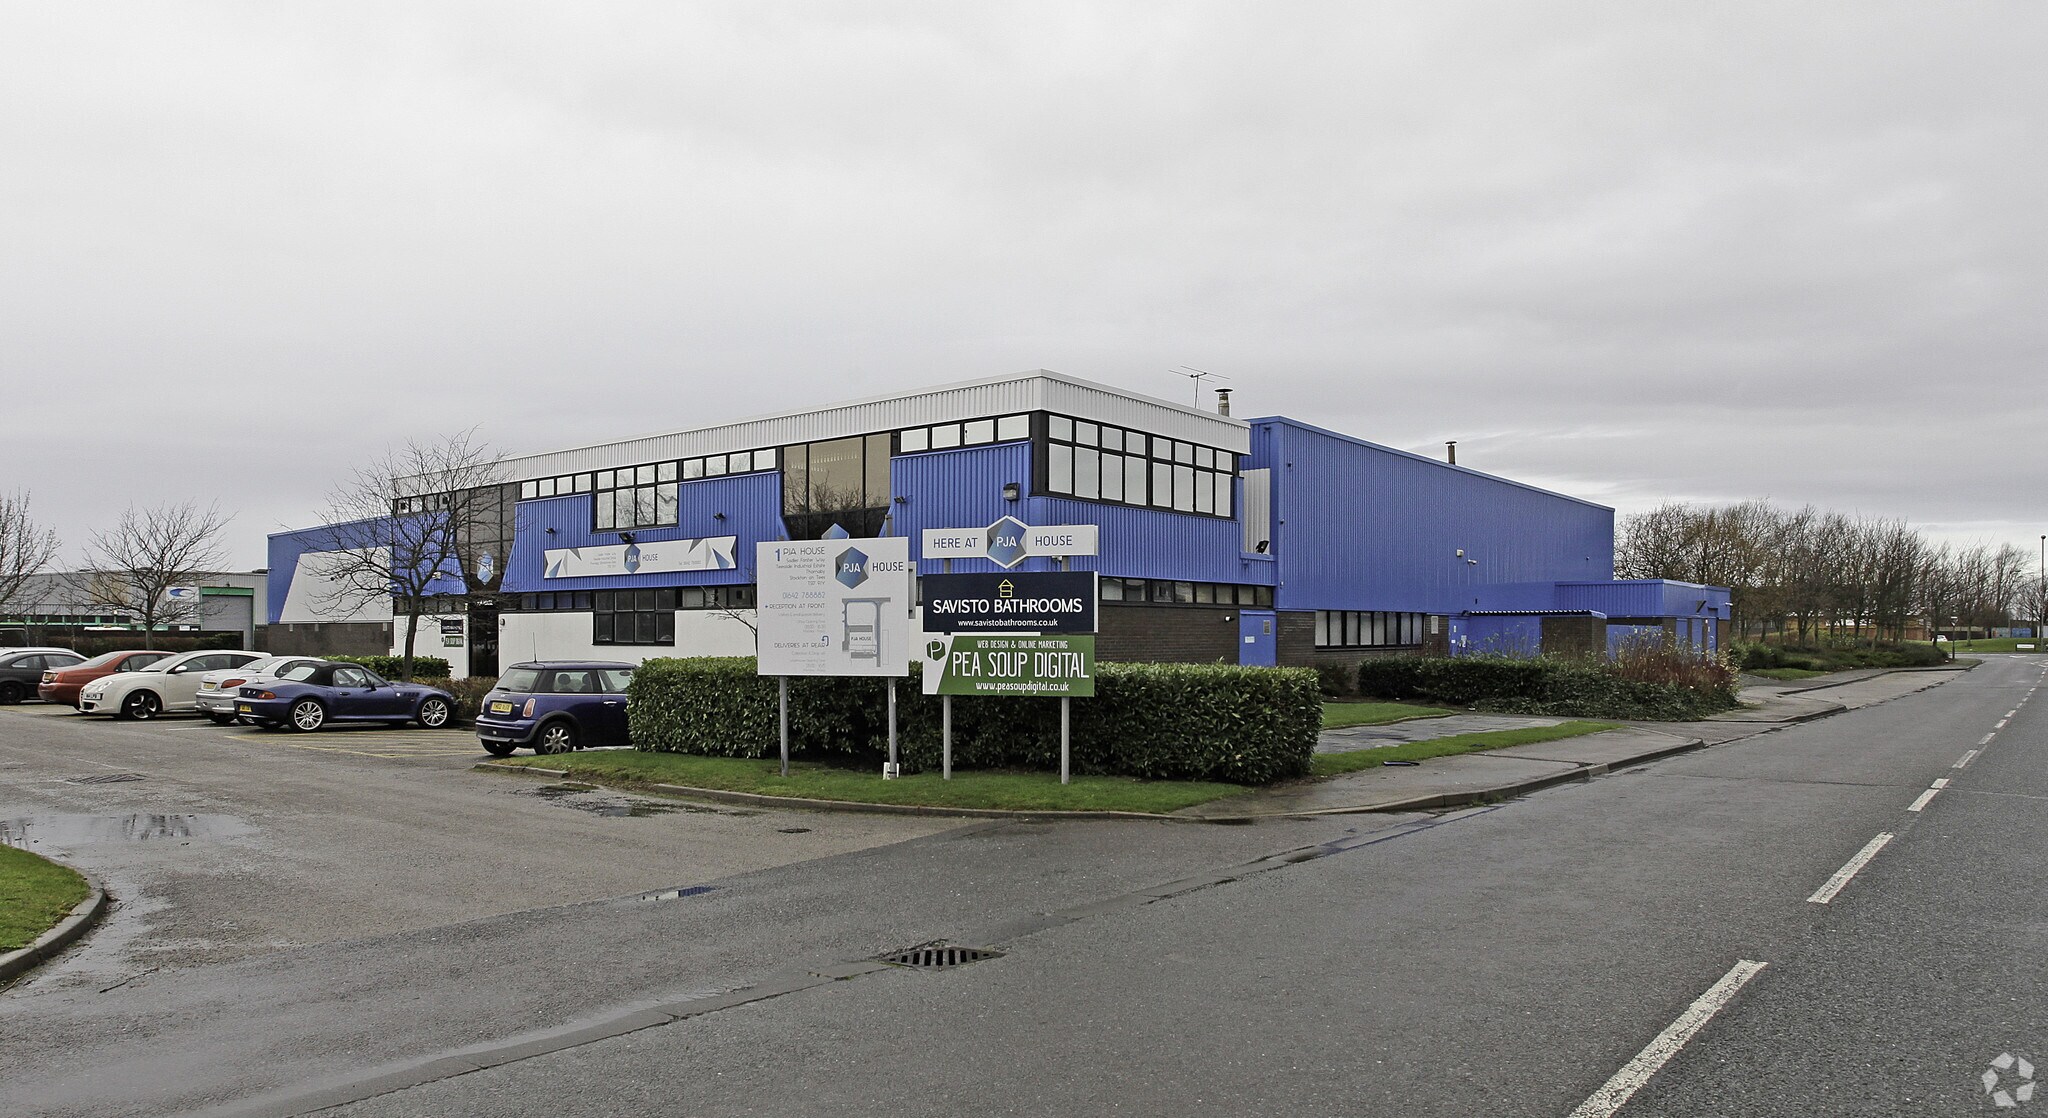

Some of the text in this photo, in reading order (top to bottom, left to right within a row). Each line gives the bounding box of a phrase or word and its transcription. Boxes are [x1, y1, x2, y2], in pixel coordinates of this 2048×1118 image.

[933, 535, 1072, 548] HERE AT PJA HOUSE
[783, 546, 825, 556] PJA HOUSE
[628, 554, 638, 562] PJA
[843, 562, 904, 573] PJA HOUSE
[932, 598, 1083, 614] SAVISTO BATHROOMS
[958, 618, 1058, 627] www.savistobathrooms.co.uk
[977, 640, 989, 649] WEB
[990, 640, 1009, 649] DESIGN
[1018, 640, 1036, 649] ONLINE
[1038, 640, 1068, 649] MARKETING
[952, 652, 1090, 678] PEA SOUP DIGITAL
[976, 680, 1070, 693] www.peasoupdigital.co.uk
